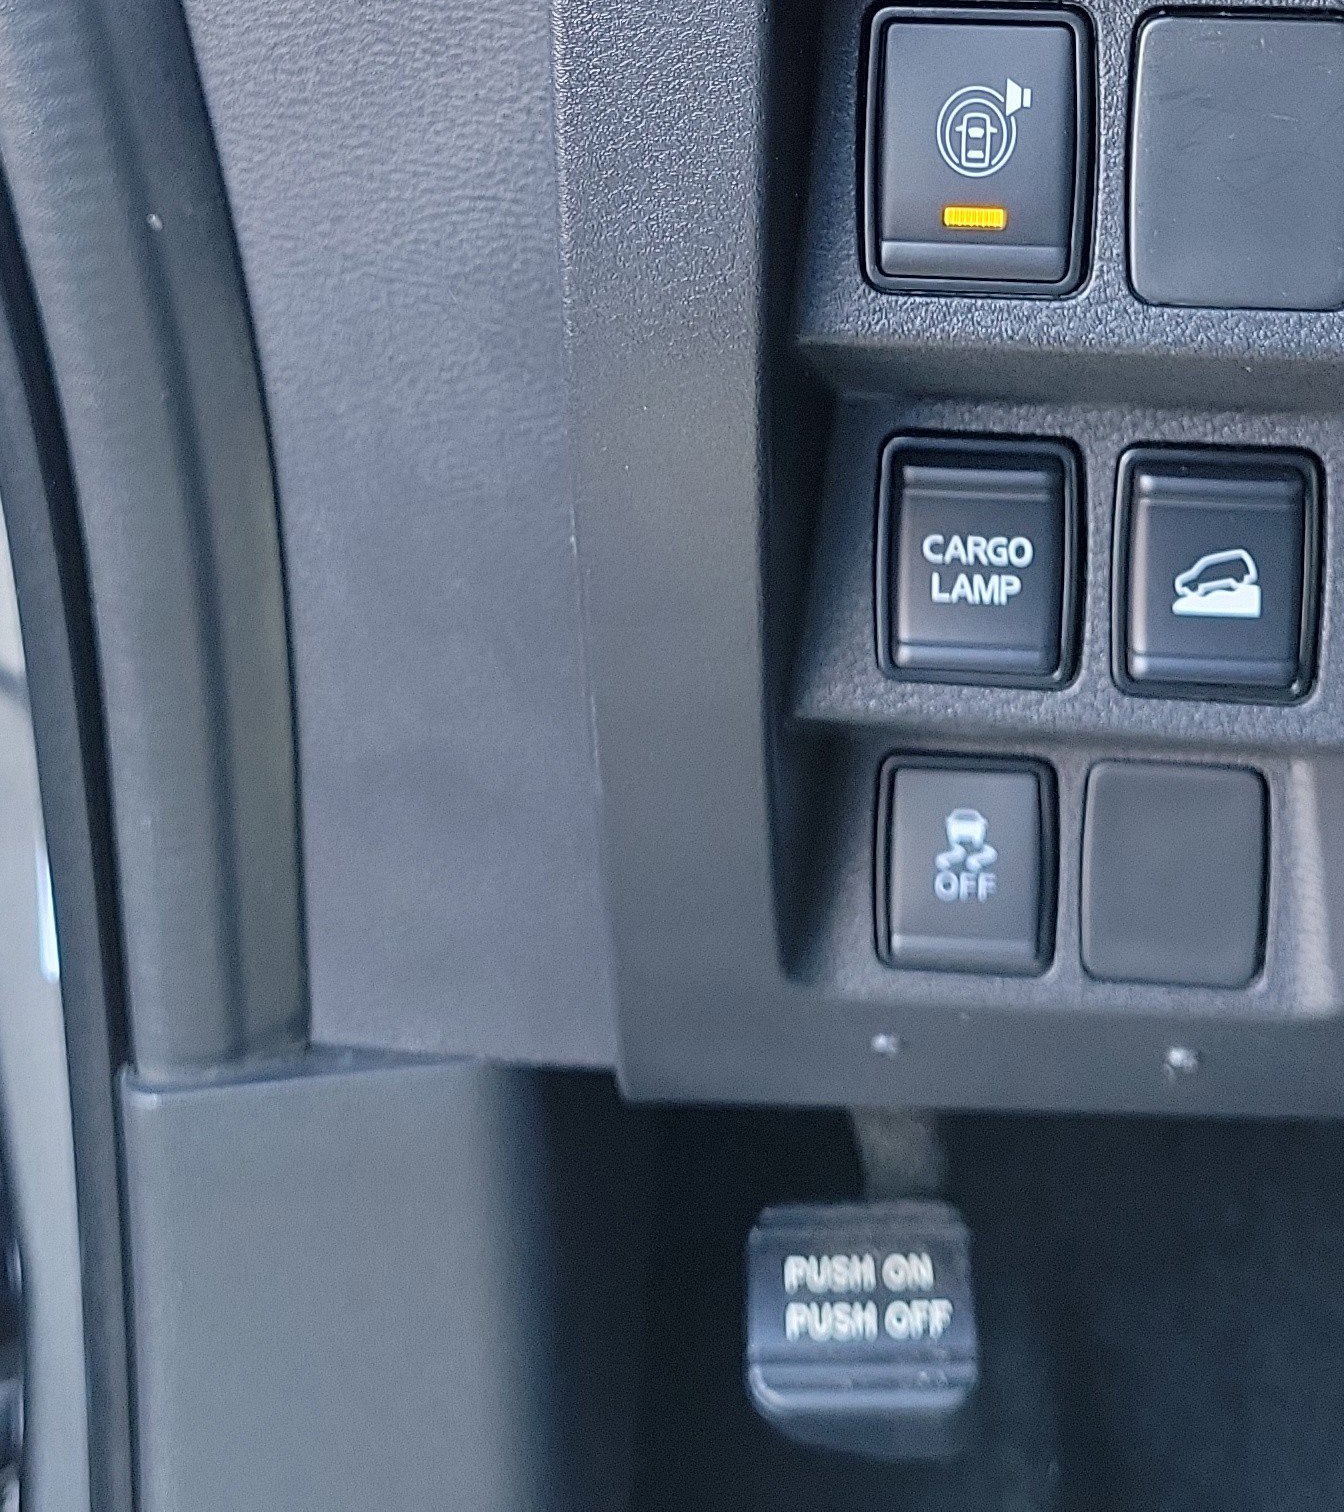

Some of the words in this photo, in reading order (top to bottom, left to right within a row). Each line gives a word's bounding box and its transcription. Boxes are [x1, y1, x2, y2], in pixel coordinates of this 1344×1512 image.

[922, 534, 1034, 569] CARGO
[930, 572, 1022, 606] LAMP
[934, 871, 997, 902] OFF
[783, 1254, 877, 1294] PUSH
[881, 1252, 934, 1292] ON
[785, 1300, 879, 1342] PUSH
[884, 1298, 954, 1339] OFF
